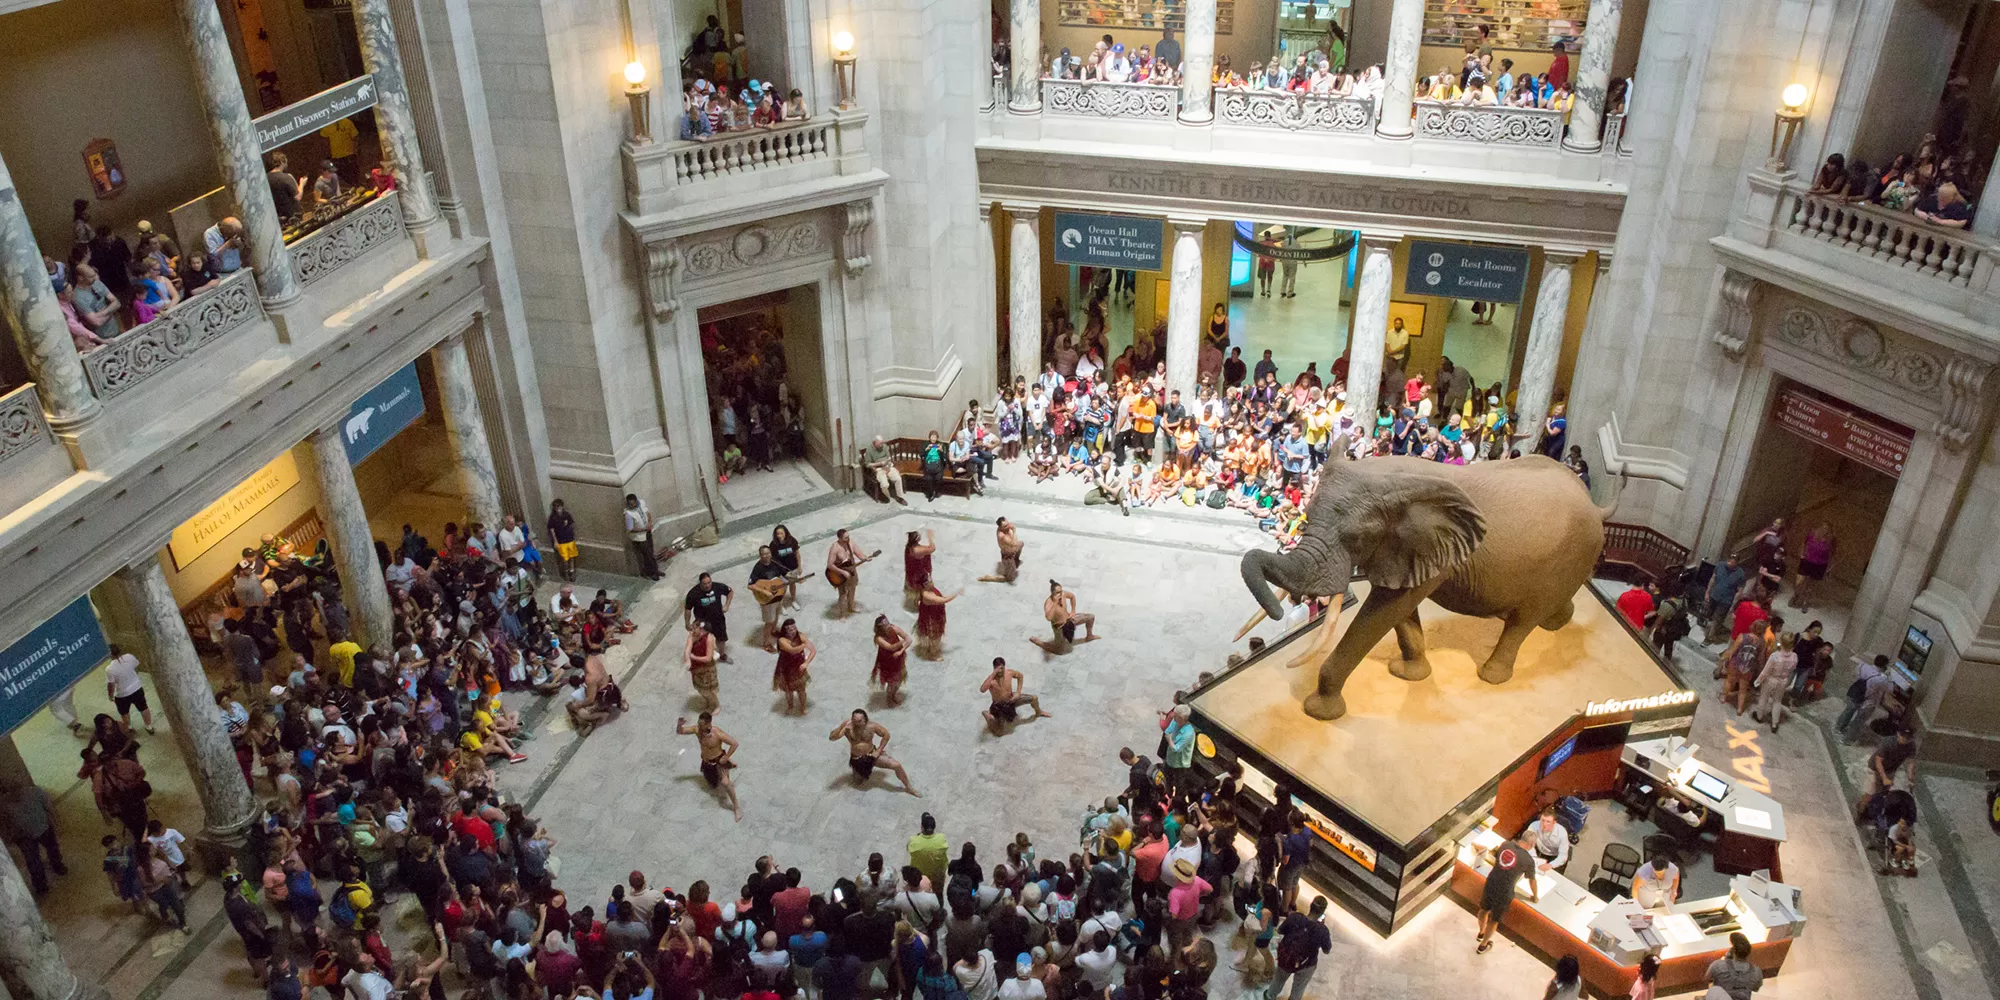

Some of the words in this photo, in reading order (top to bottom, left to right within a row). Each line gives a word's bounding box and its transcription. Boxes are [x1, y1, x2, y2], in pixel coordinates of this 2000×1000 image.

[257, 122, 294, 143] Elephant
[293, 108, 330, 128] Discovery
[330, 96, 357, 113] Station
[1107, 174, 1191, 194] KENNETH
[1220, 182, 1299, 202] BEHRING
[1308, 186, 1373, 208] FAMILY
[1379, 194, 1472, 216] ROTUNDA
[1088, 225, 1116, 235] Ocean
[1118, 227, 1138, 237] Hall
[1120, 238, 1156, 249] Theater
[1088, 246, 1120, 257] Human
[1123, 249, 1156, 261] Origins
[1460, 258, 1481, 269] Rest
[1484, 260, 1517, 273] Rooms
[1458, 276, 1503, 289] Escalator
[379, 386, 411, 413] Mammals
[193, 521, 219, 544] HALL
[219, 511, 231, 526] OF
[232, 475, 280, 517] MAMMALS
[0, 637, 58, 683] Mammals
[4, 657, 58, 700] Museum
[58, 633, 90, 660] Store
[1585, 690, 1695, 717] Information
